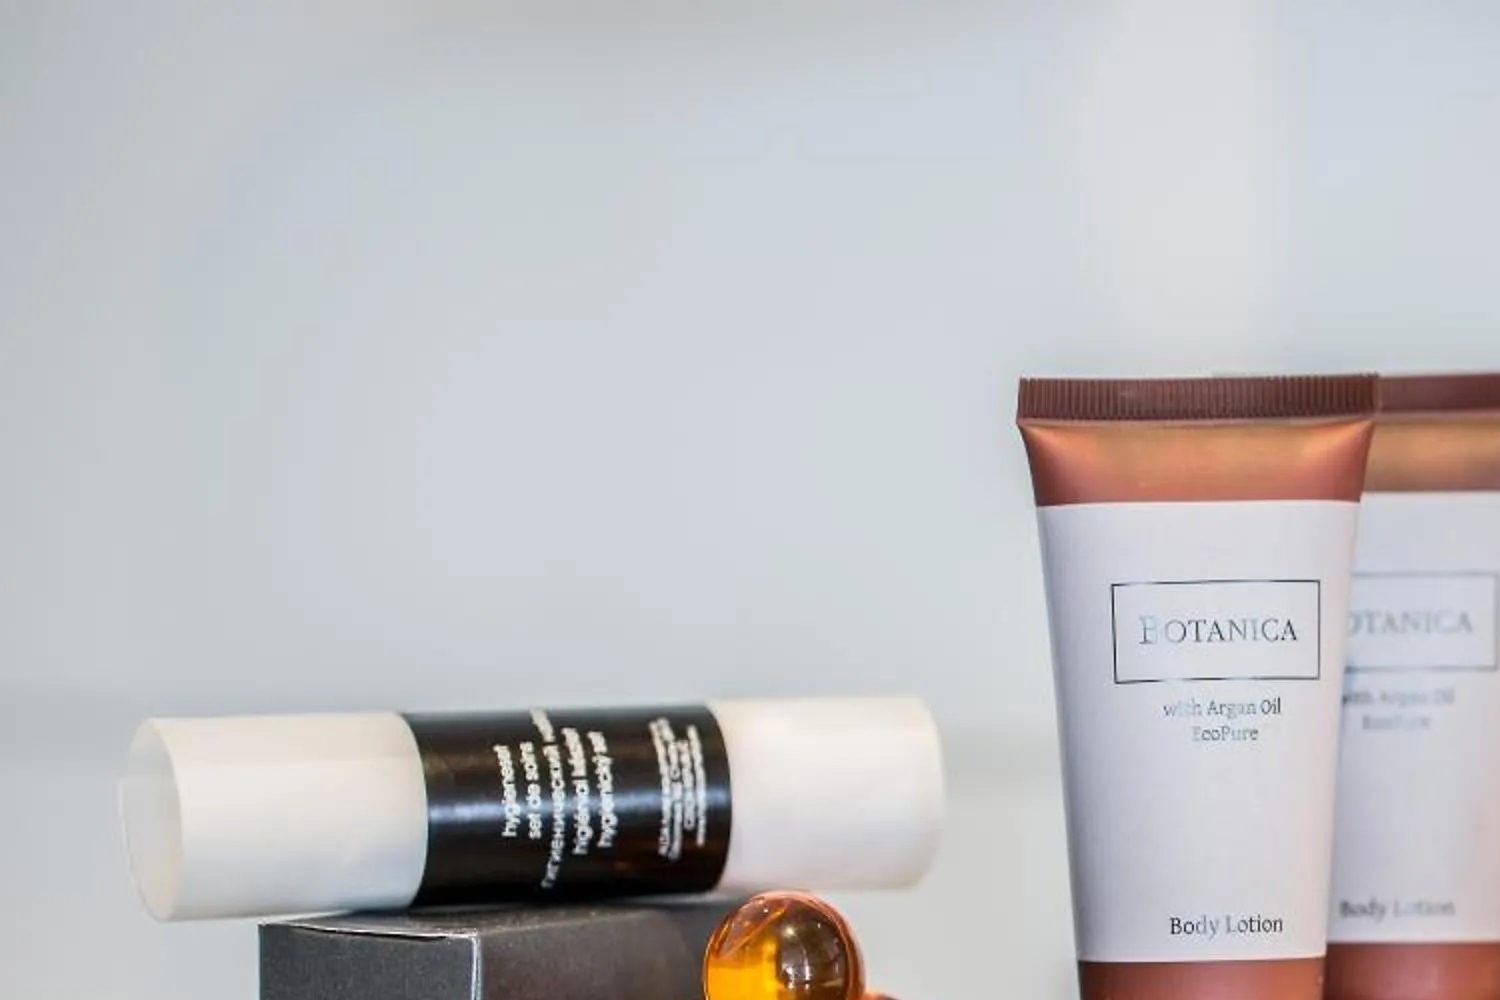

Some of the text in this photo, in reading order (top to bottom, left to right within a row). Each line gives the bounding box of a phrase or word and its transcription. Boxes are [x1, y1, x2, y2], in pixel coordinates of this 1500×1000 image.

[1138, 615, 1298, 645] BOTANICA
[1349, 610, 1473, 635] OTANICA
[1162, 697, 1281, 719] with Argan Oil
[1191, 725, 1259, 741] EcoPure
[1169, 914, 1283, 941] Body Lotion
